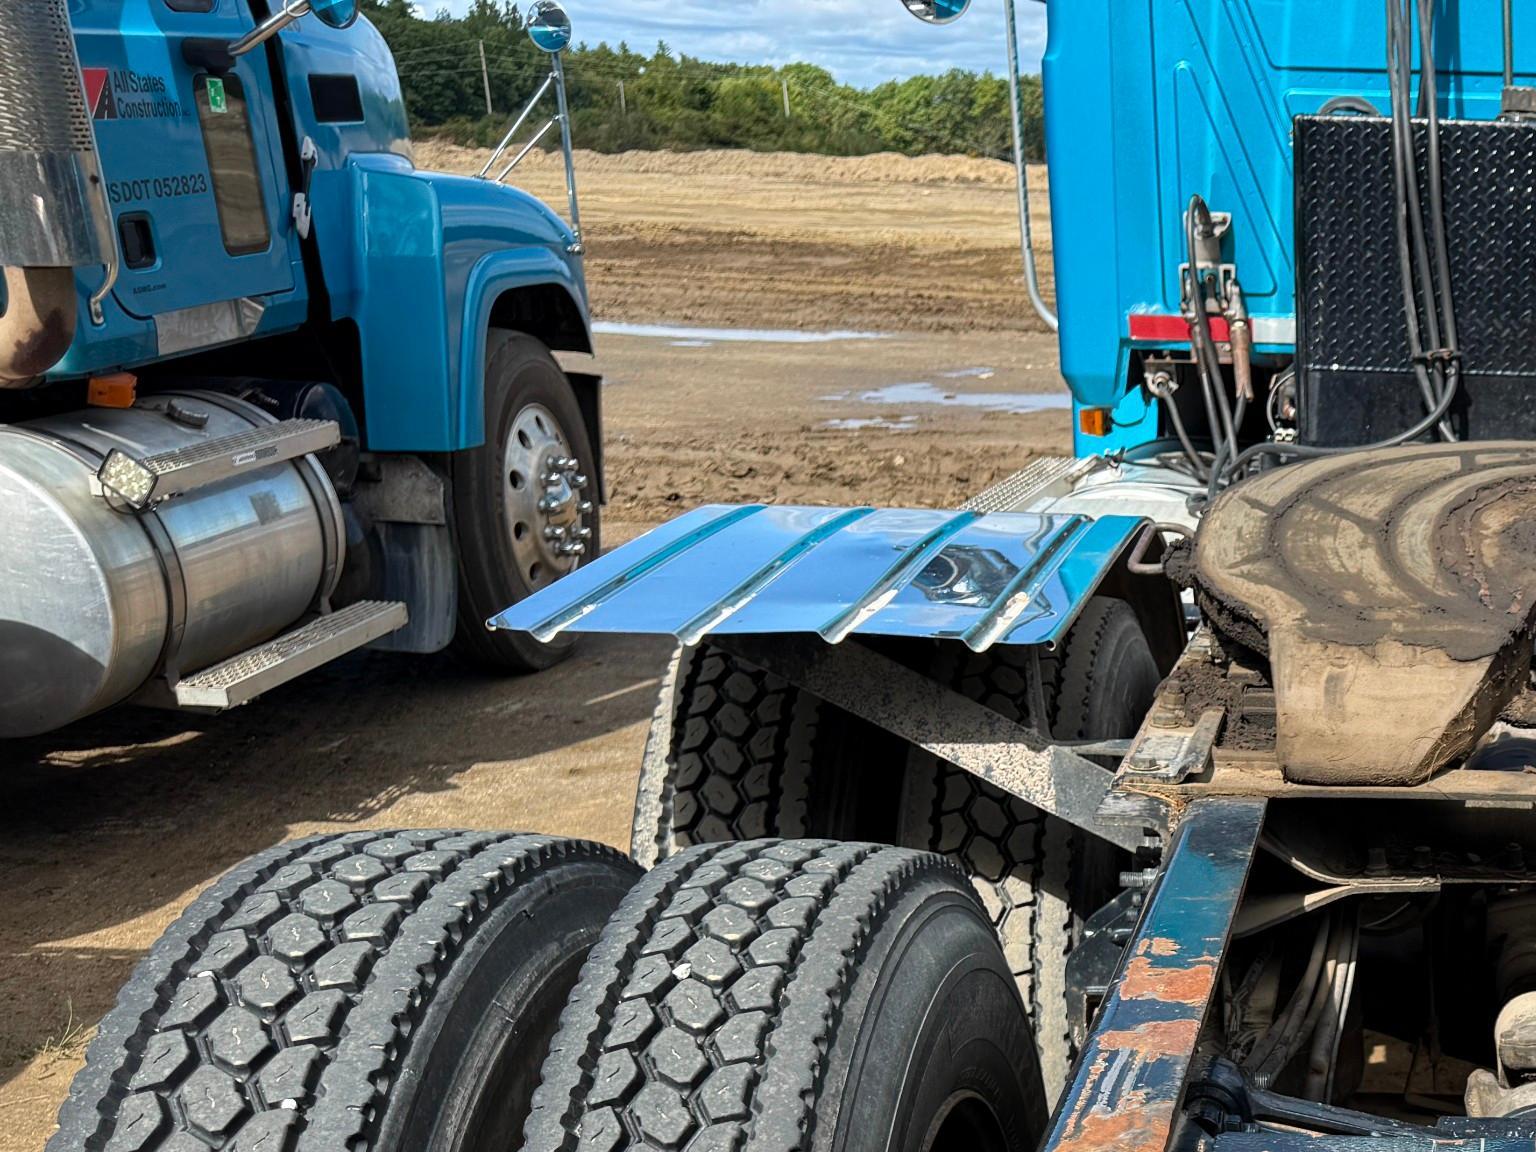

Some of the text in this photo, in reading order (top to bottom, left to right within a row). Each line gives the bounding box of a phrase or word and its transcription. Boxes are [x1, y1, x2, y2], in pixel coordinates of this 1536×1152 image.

[113, 71, 166, 93] All States
[117, 98, 182, 118] Construction
[153, 174, 207, 198] 052823
